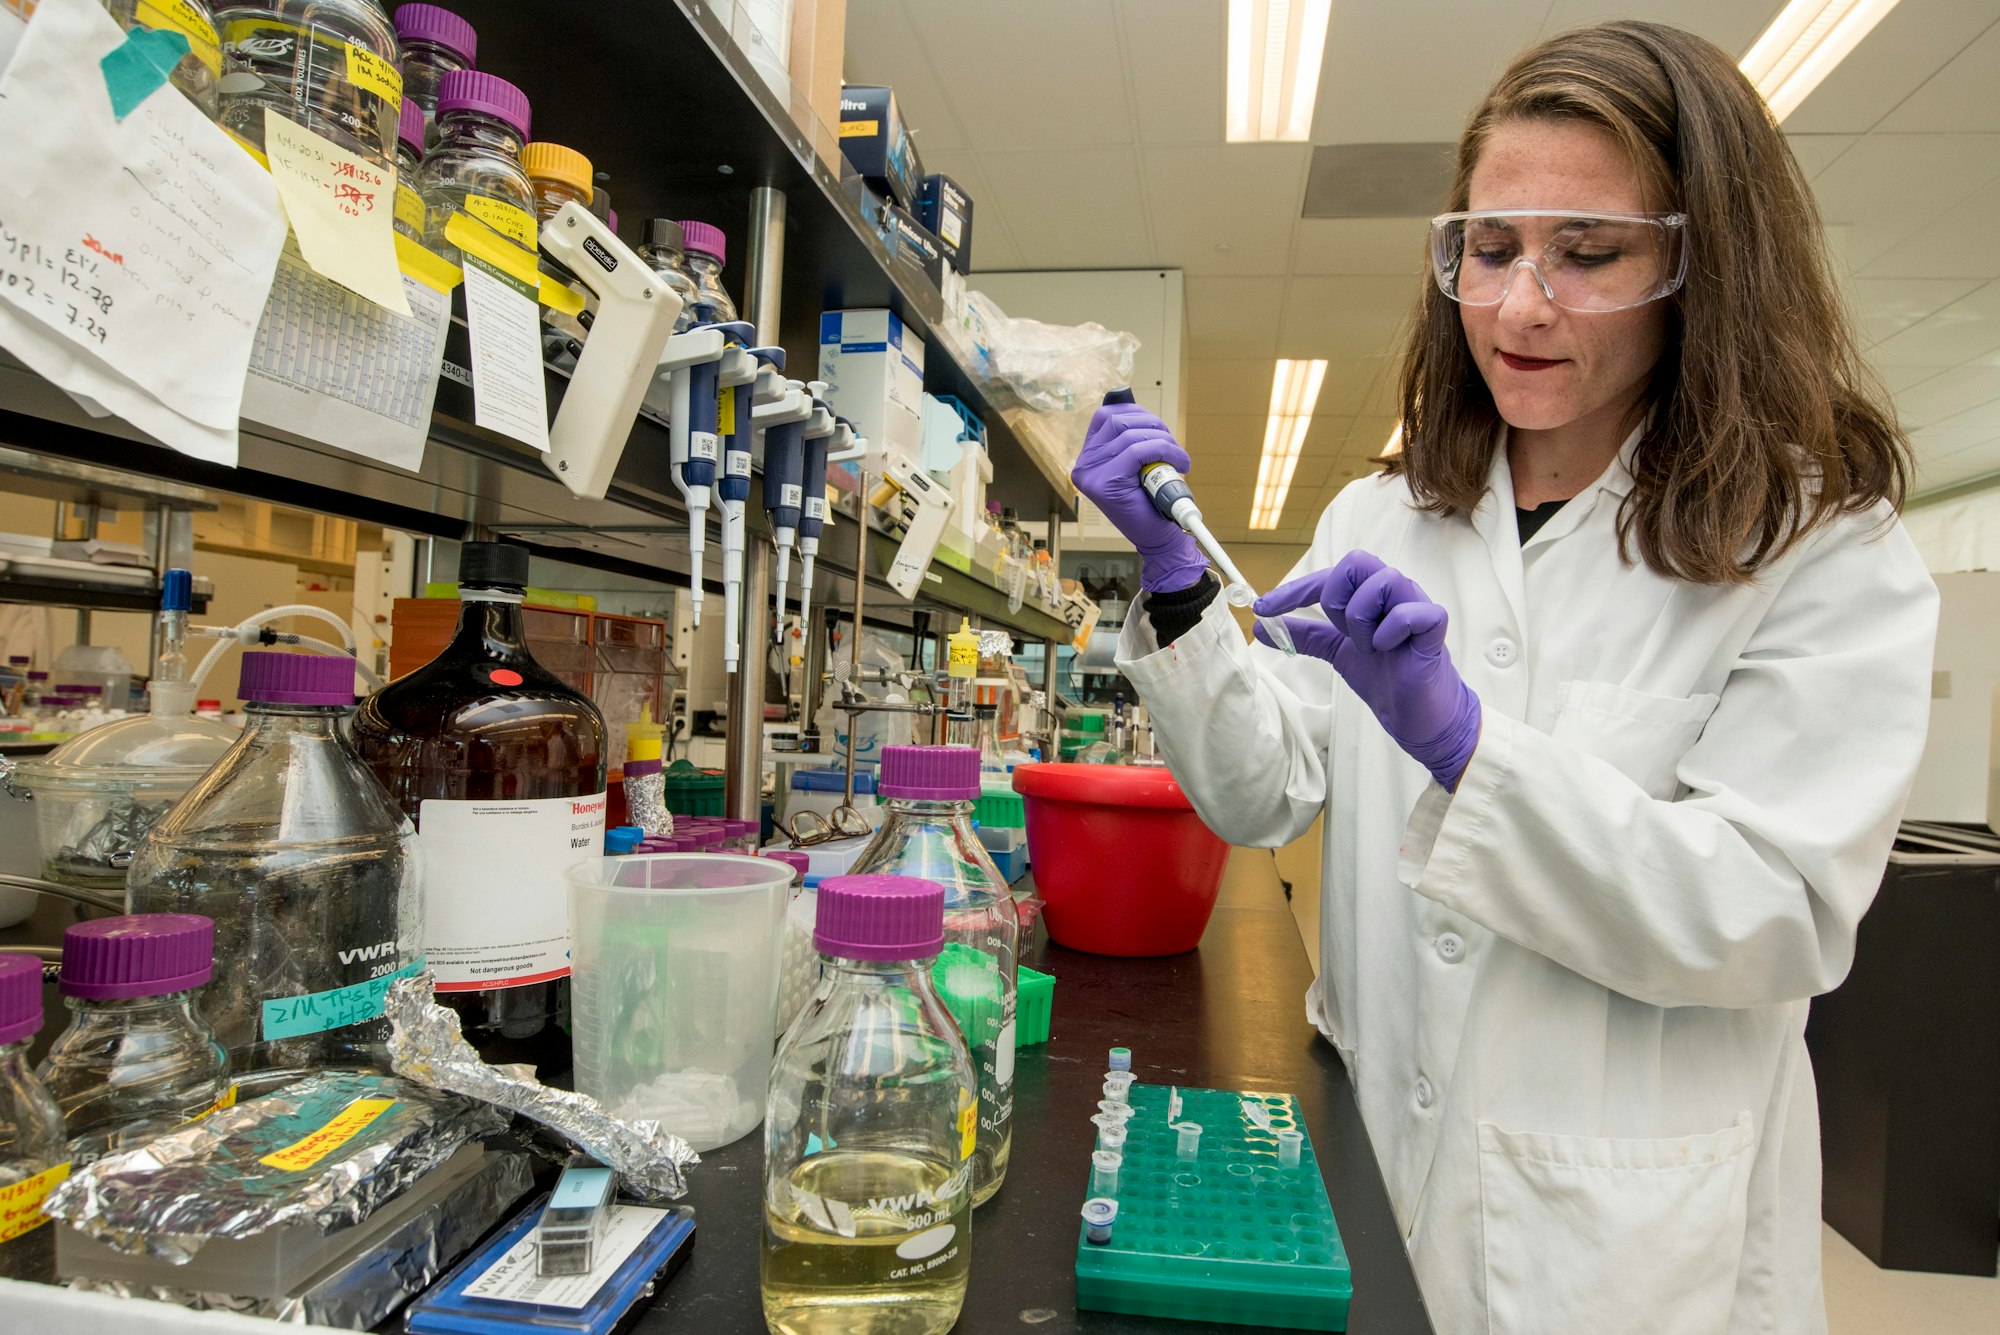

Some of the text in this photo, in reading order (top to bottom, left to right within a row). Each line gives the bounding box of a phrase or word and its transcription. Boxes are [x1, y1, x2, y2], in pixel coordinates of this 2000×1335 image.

[348, 35, 368, 50] 400
[341, 112, 361, 129] 200
[439, 177, 456, 186] 200
[65, 302, 108, 344] 7.29
[571, 822, 590, 831] Burdick
[570, 837, 591, 849] Water
[338, 941, 396, 965] VWR
[370, 960, 396, 979] 2000
[470, 962, 533, 975] Not dangerous goods
[274, 1130, 335, 1161] Amanda
[867, 1190, 934, 1214] VWR
[906, 1202, 952, 1232] 500 mL
[471, 1265, 515, 1295] VWR
[890, 1267, 909, 1279] CAT.
[910, 1263, 926, 1275] NO.
